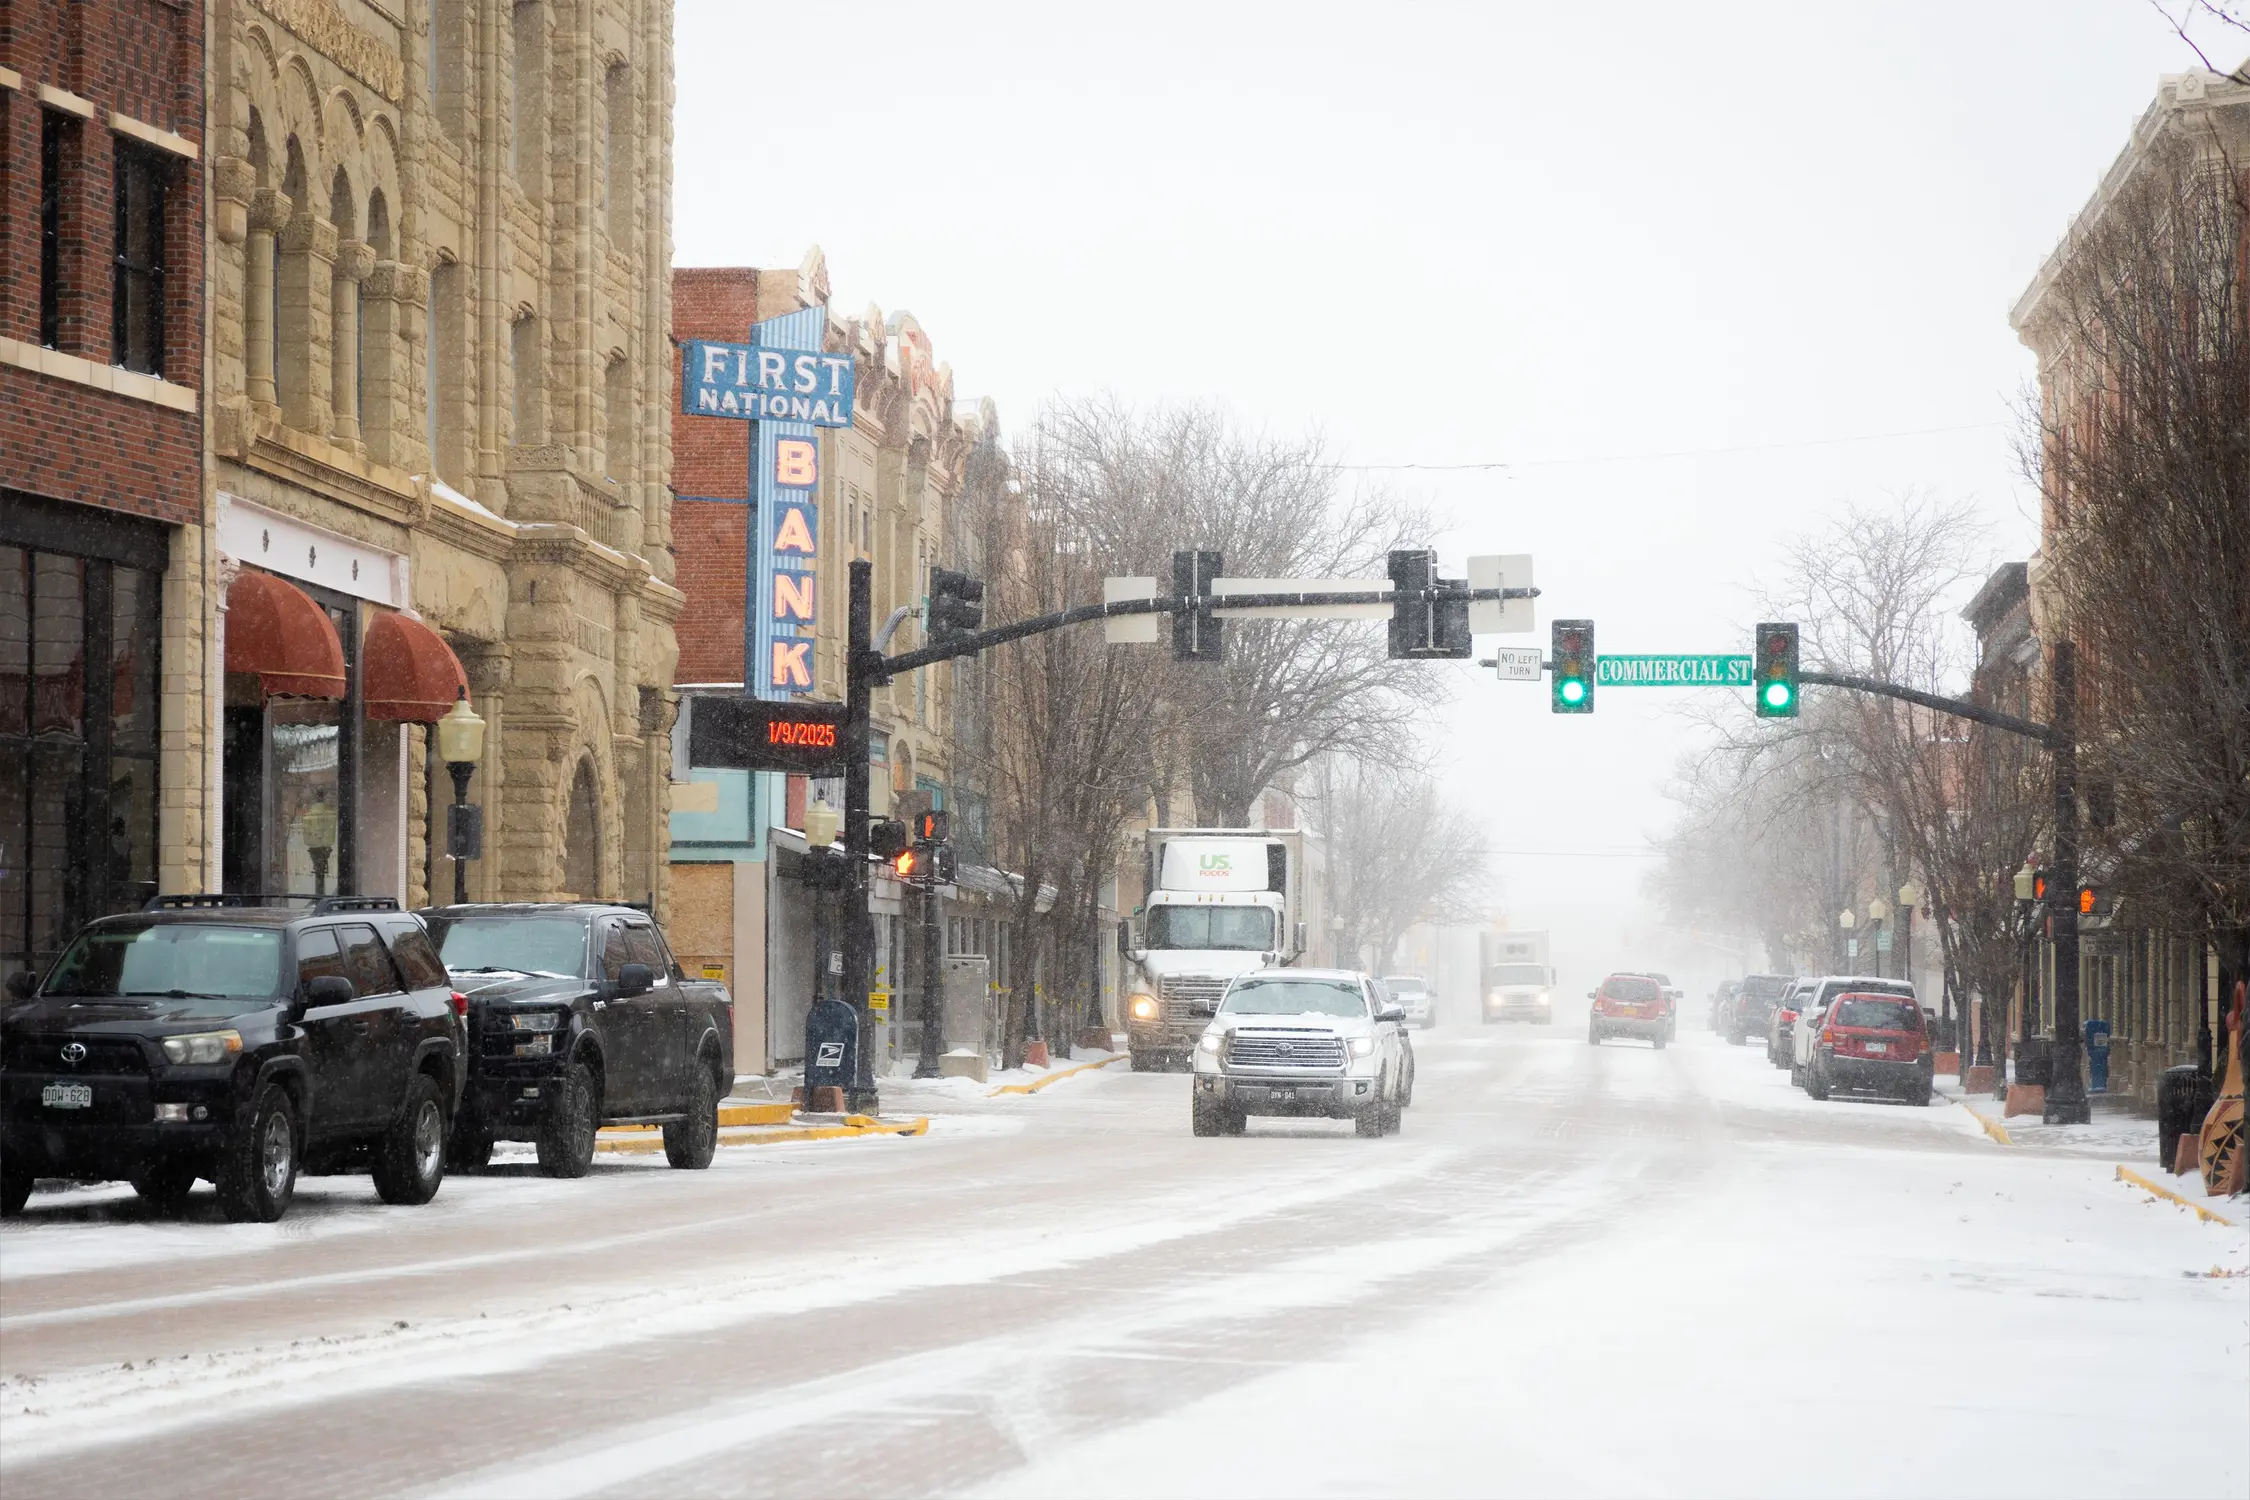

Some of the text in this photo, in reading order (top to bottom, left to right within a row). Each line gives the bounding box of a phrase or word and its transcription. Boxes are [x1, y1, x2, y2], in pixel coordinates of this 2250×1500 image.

[702, 345, 850, 396] FIRST
[699, 388, 848, 424] NATIONAL
[773, 440, 816, 686] BANK
[1501, 653, 1538, 665] NO LEFT
[1509, 666, 1531, 676] TURN
[1599, 660, 1750, 681] COMMERCIAL ST
[769, 721, 835, 746] 1/9/2025
